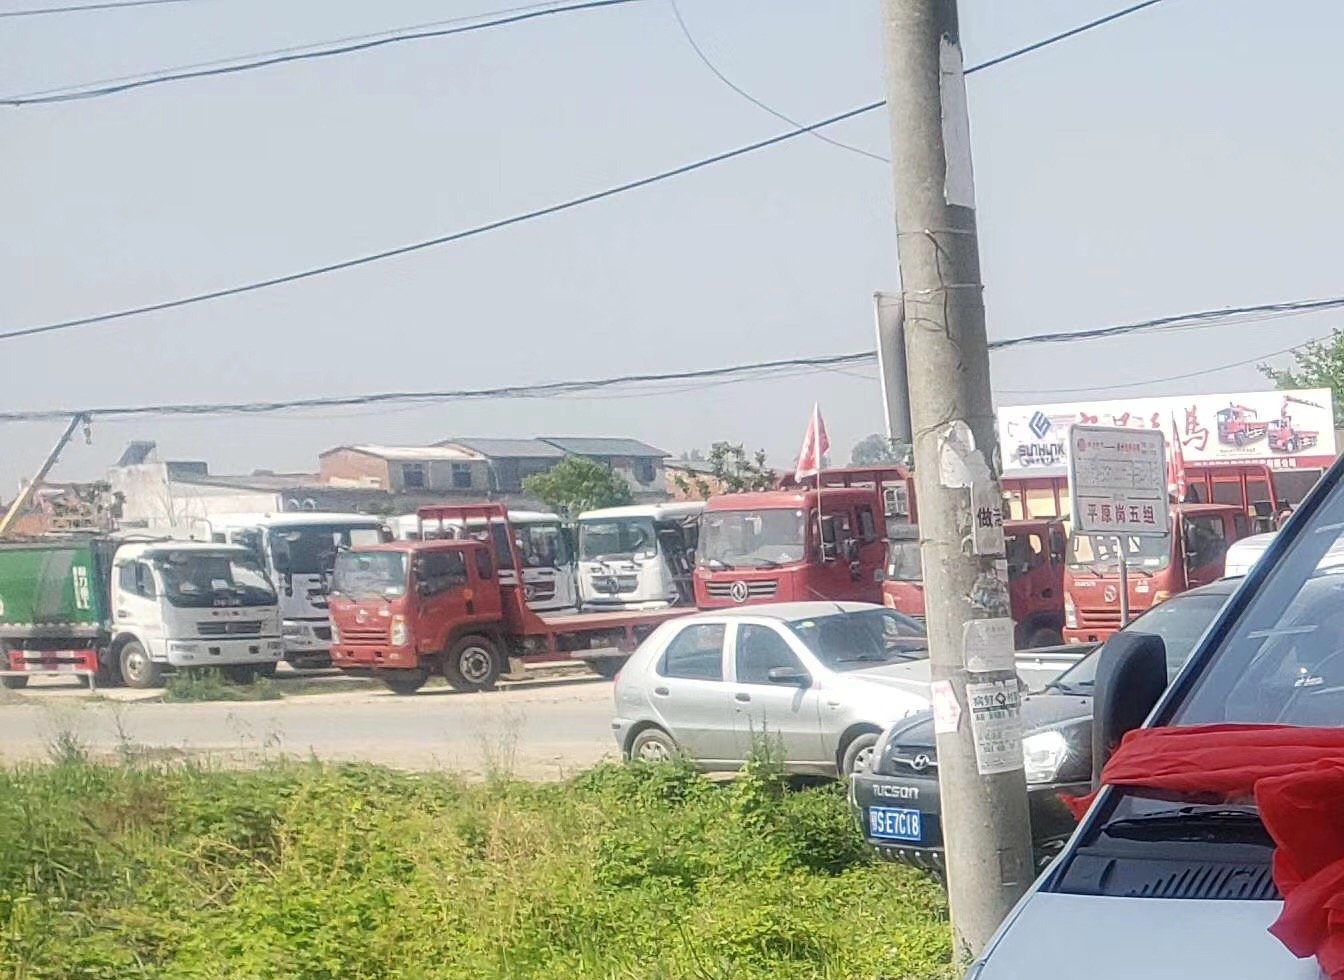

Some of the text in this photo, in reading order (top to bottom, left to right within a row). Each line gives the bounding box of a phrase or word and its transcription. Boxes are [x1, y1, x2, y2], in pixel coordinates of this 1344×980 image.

[1087, 503, 1156, 524] 平原岗五组
